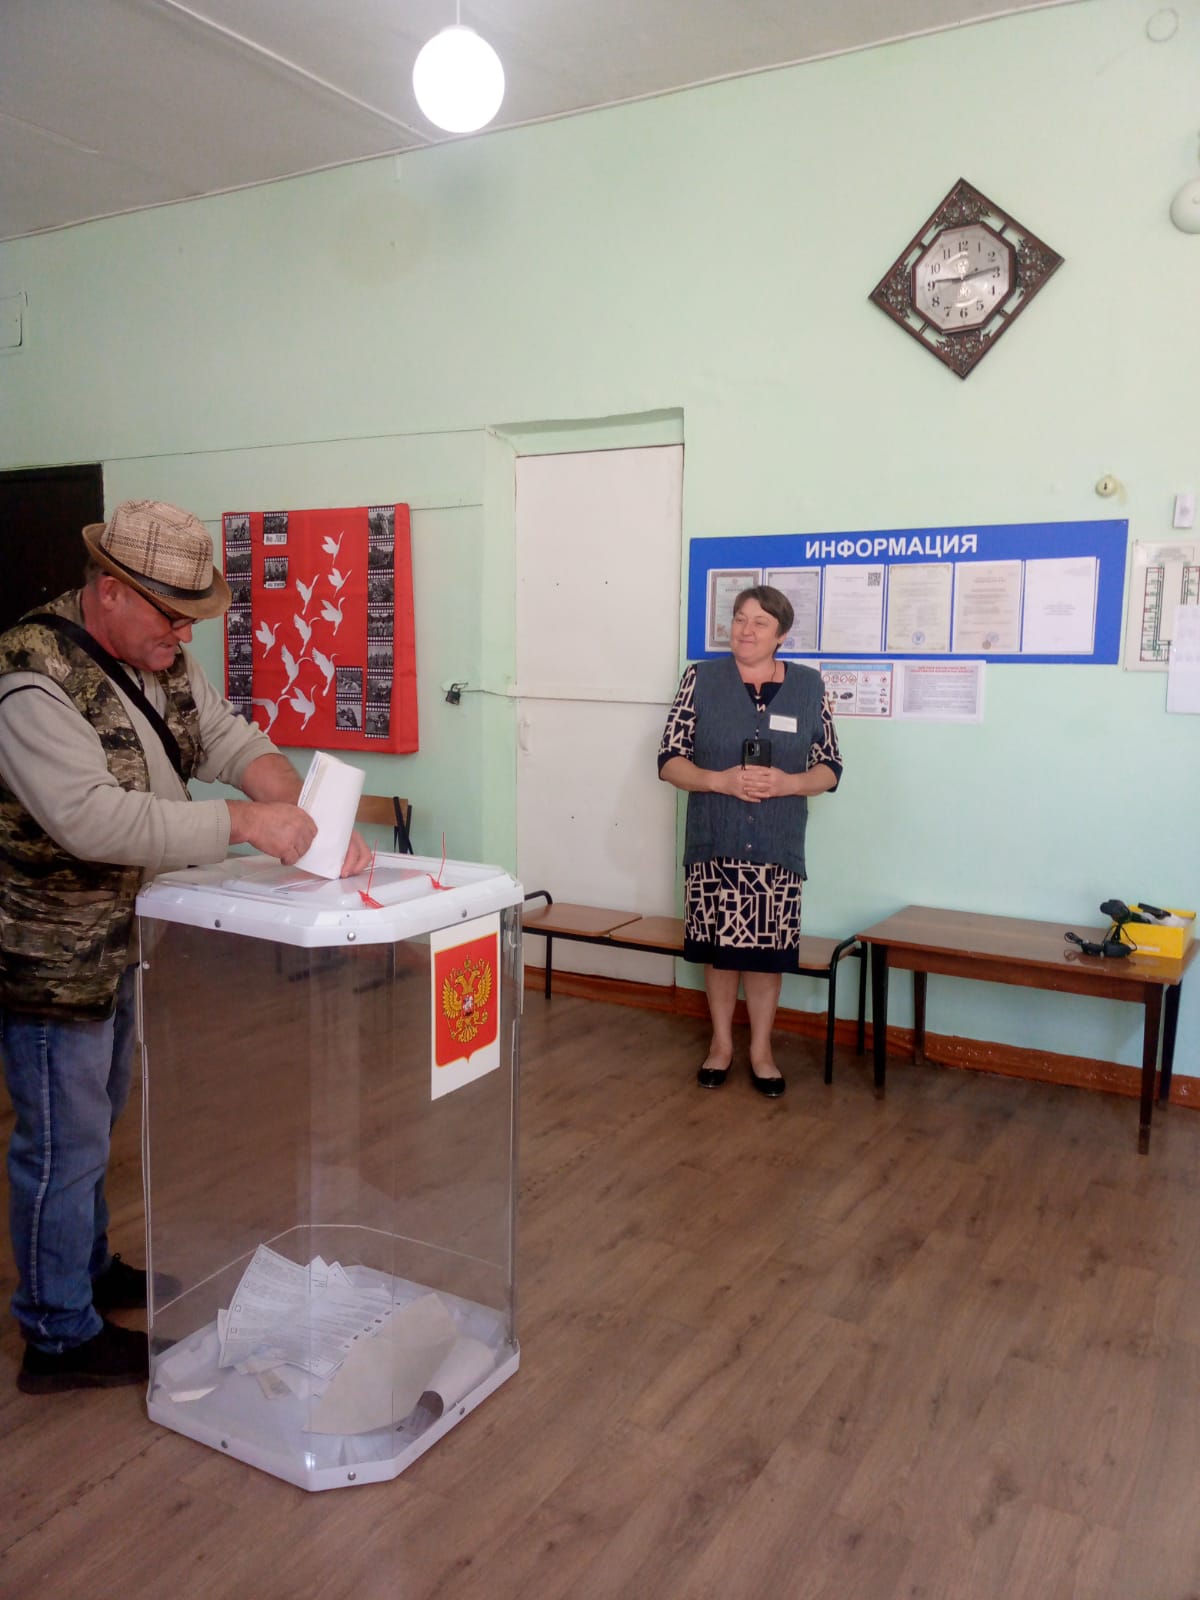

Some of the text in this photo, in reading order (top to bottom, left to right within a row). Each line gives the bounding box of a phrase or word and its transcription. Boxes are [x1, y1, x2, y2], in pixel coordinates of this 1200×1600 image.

[959, 241, 968, 252] 12
[943, 248, 951, 260] 11
[988, 251, 996, 262] 2
[931, 263, 941, 274] 10
[992, 266, 1001, 278] 3
[927, 281, 936, 291] 9
[932, 296, 940, 307] 8
[976, 300, 985, 311] 5
[944, 306, 953, 317] 7
[960, 307, 968, 318] 6
[804, 533, 978, 559] ИНФОРМАЦИЯ
